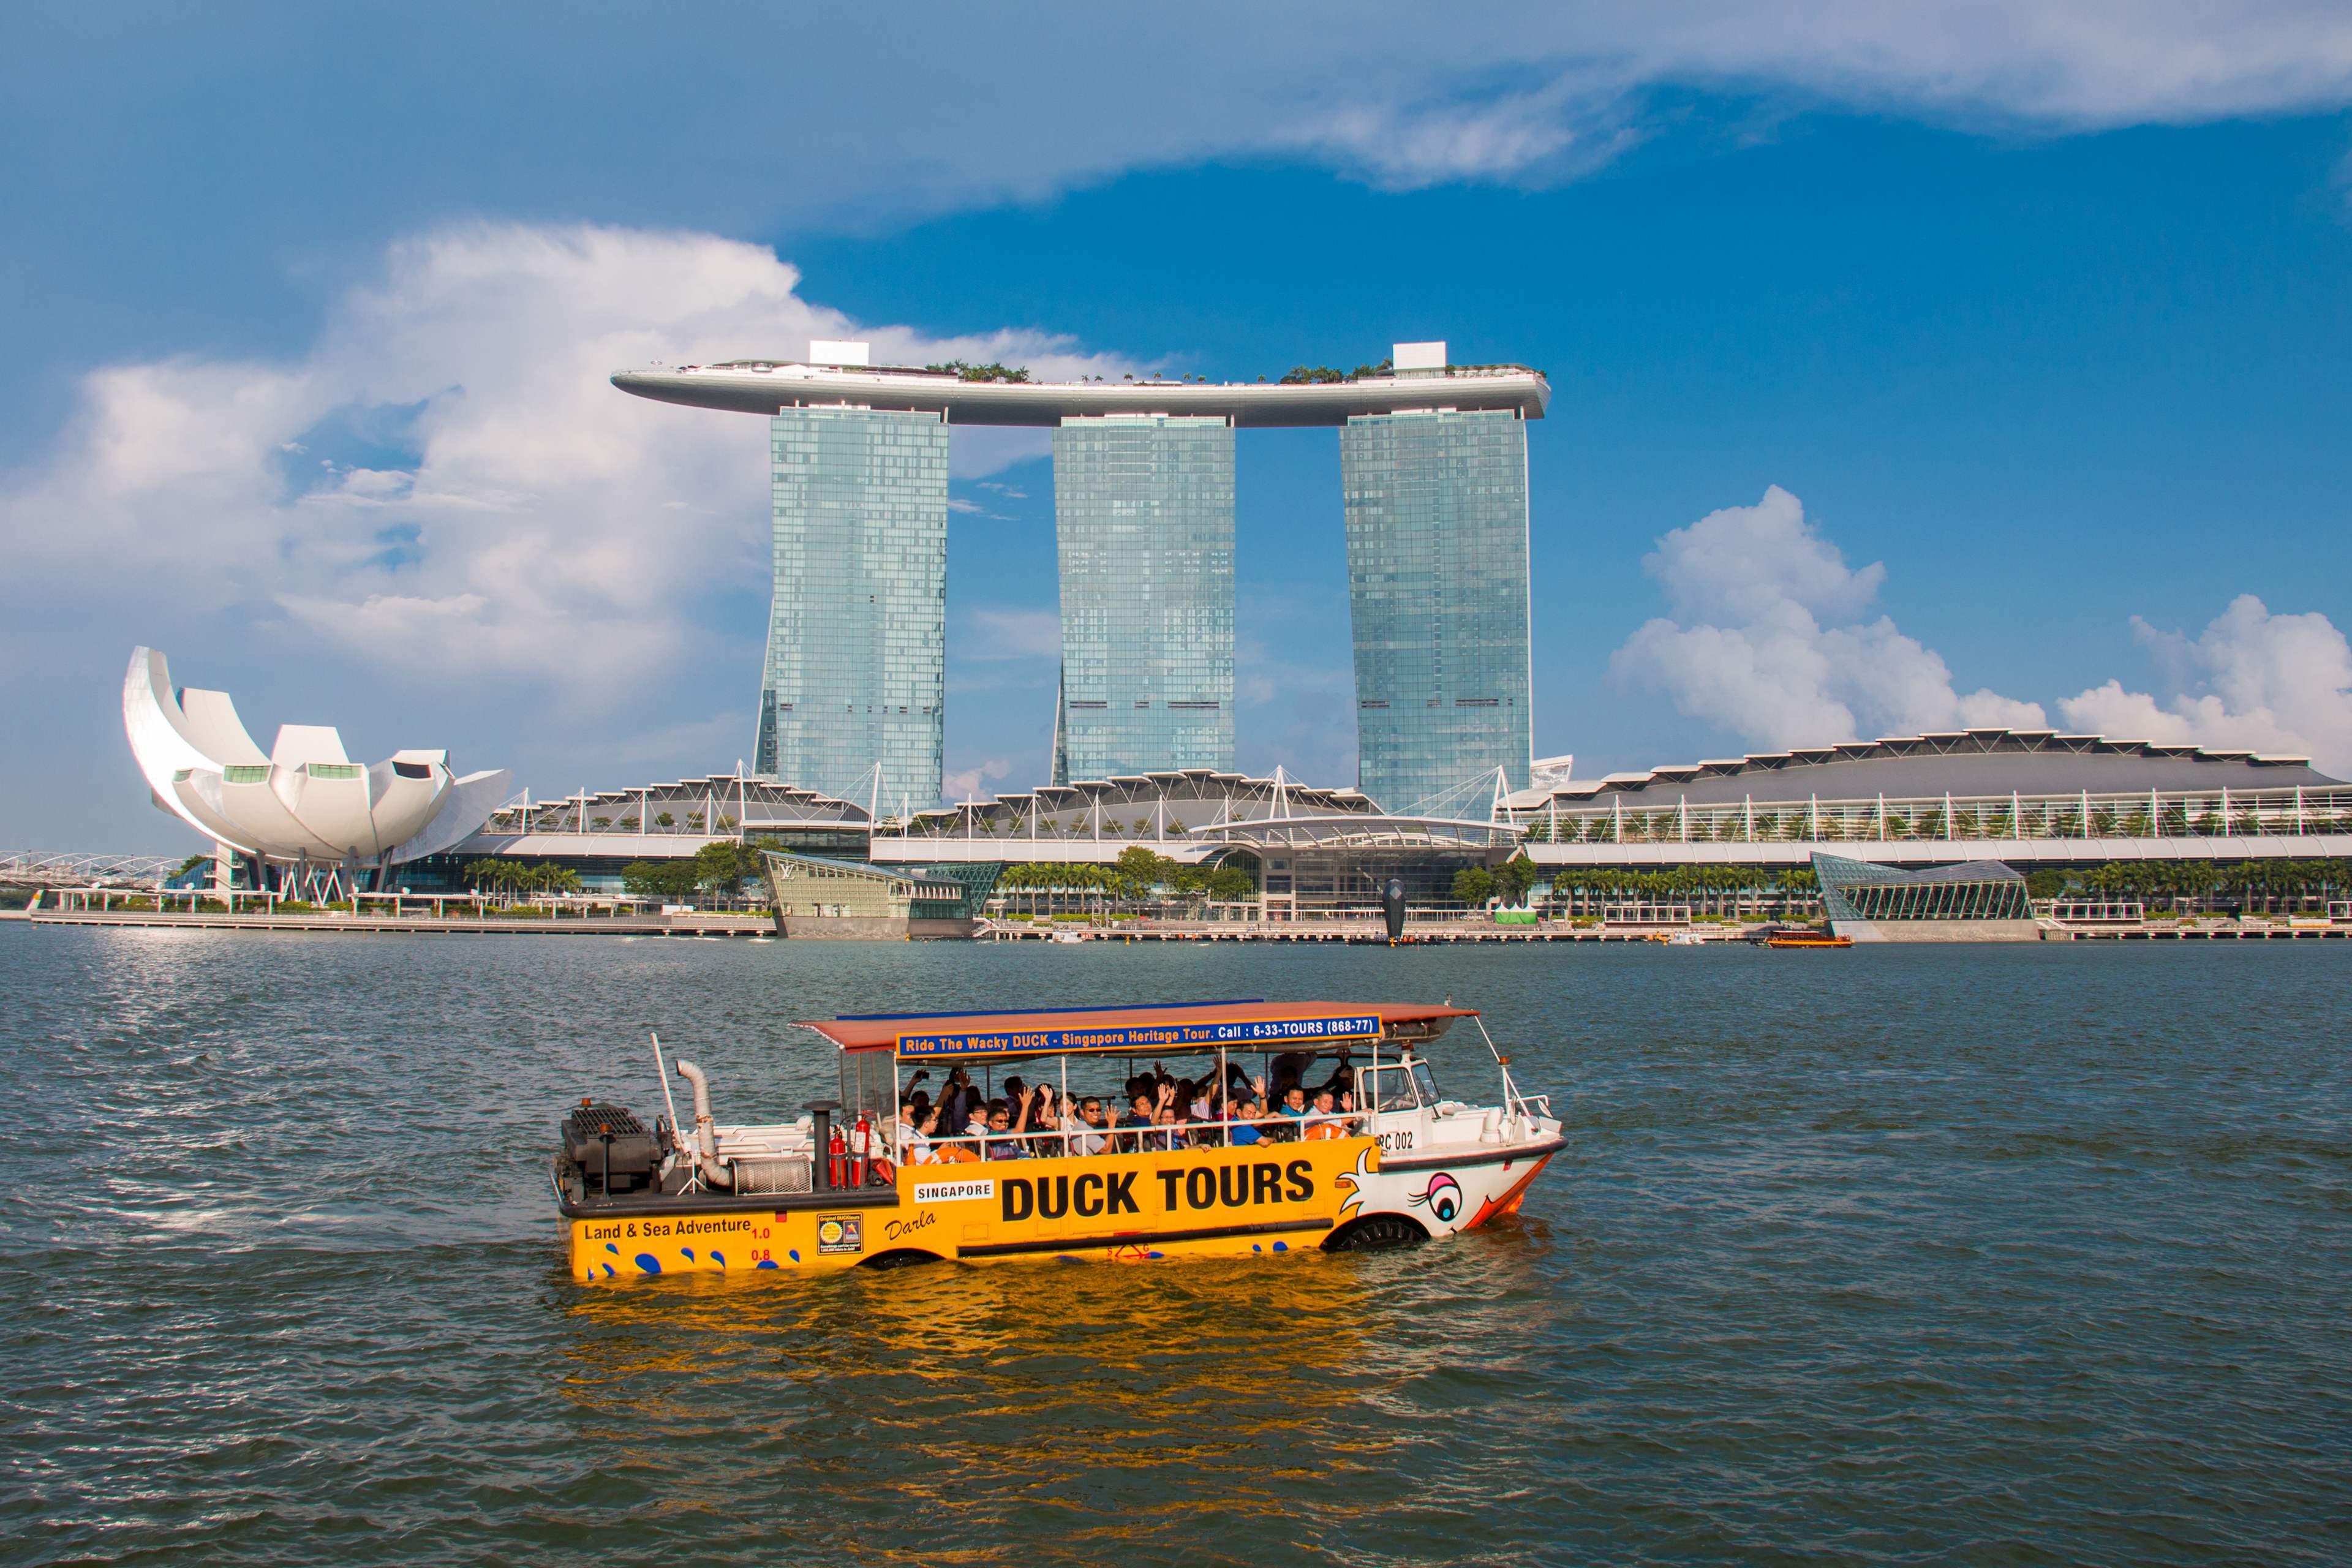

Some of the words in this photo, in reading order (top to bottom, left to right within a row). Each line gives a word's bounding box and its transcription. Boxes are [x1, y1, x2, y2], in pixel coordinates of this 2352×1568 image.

[906, 1039, 935, 1052] Ride
[940, 1038, 963, 1050] The
[967, 1036, 1008, 1050] Wacky
[1012, 1034, 1049, 1048] DUCK
[1062, 1033, 1125, 1046] Singapore
[1129, 1028, 1179, 1043] Heritage
[1183, 1028, 1213, 1039] Tour.
[1218, 1026, 1241, 1038] Call
[1253, 1022, 1323, 1036] 6-33-TOURS
[1327, 1019, 1373, 1034] (868-77)
[1395, 1131, 1412, 1150] 002
[919, 1185, 990, 1199] SINGAPORE
[1002, 1171, 1140, 1222] DUCK
[1156, 1160, 1314, 1212] TOURS
[585, 1224, 620, 1240] Land
[627, 1223, 637, 1237] &
[643, 1223, 670, 1237] Sea
[676, 1219, 751, 1235] Adventure
[752, 1228, 770, 1239] 1.0
[884, 1210, 937, 1240] Darla
[752, 1250, 770, 1261] 0.8
